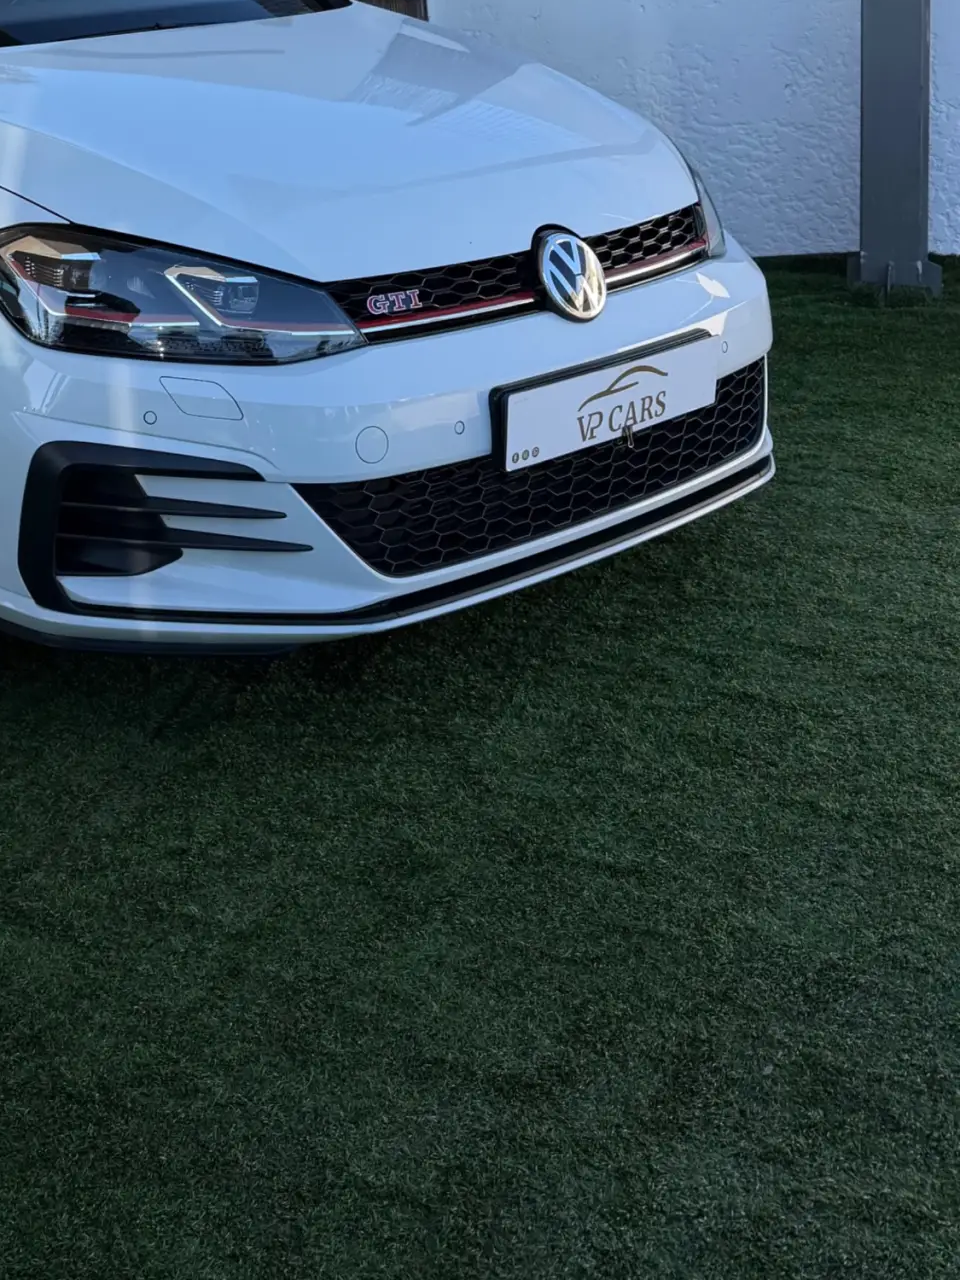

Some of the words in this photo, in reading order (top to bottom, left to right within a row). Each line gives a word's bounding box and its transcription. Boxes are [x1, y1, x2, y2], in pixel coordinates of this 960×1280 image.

[367, 289, 423, 315] GTI
[576, 411, 604, 442] VP
[608, 390, 667, 433] CARS
